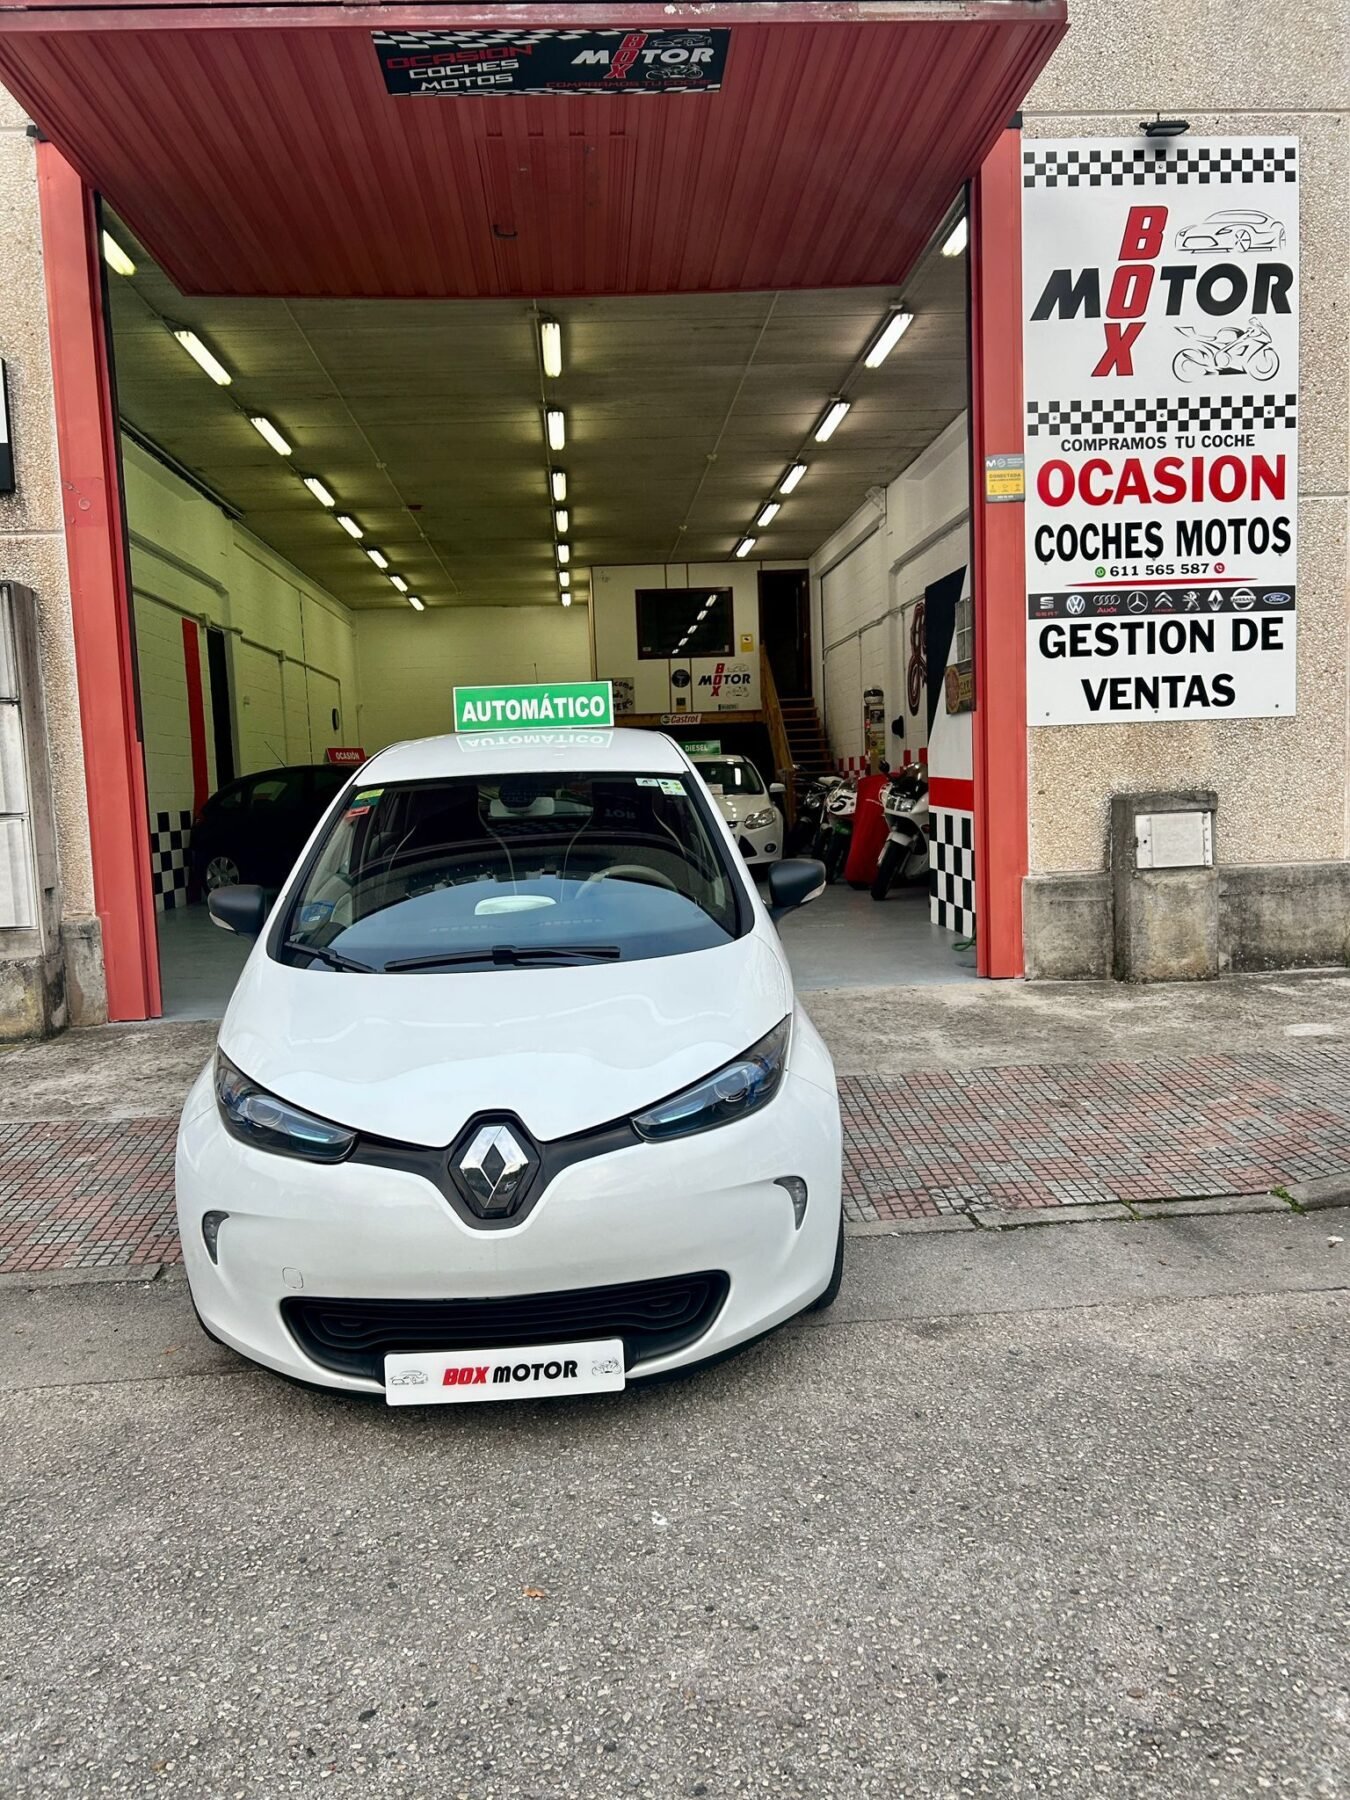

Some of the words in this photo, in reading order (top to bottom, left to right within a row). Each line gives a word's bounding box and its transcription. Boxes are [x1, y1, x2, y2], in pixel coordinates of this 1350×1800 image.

[386, 43, 533, 69] OCASION
[409, 58, 520, 79] COCHES
[603, 33, 648, 79] BOX
[420, 73, 513, 91] MOTOS
[545, 80, 639, 88] COMPRAMOS
[644, 79, 660, 87] TU
[1091, 205, 1169, 377] BOX
[1061, 436, 1167, 452] COMPRAMOS
[1175, 435, 1196, 449] TU
[1201, 434, 1256, 448] COCHE
[1036, 454, 1286, 507] OCASION
[1034, 520, 1164, 562] COCHES
[1176, 516, 1291, 557] MOTOS
[1110, 564, 1138, 577] 611
[1145, 563, 1175, 576] 565
[1180, 562, 1210, 575] 587
[1039, 619, 1215, 658] GESTION
[1231, 617, 1284, 652] DE
[1081, 673, 1236, 711] VENTAS
[462, 693, 605, 722] AUTOMÁTICO
[671, 714, 699, 724] Castrol
[684, 744, 708, 752] DIESEL
[442, 1366, 490, 1386] BOX
[492, 1360, 578, 1384] MOTOR
